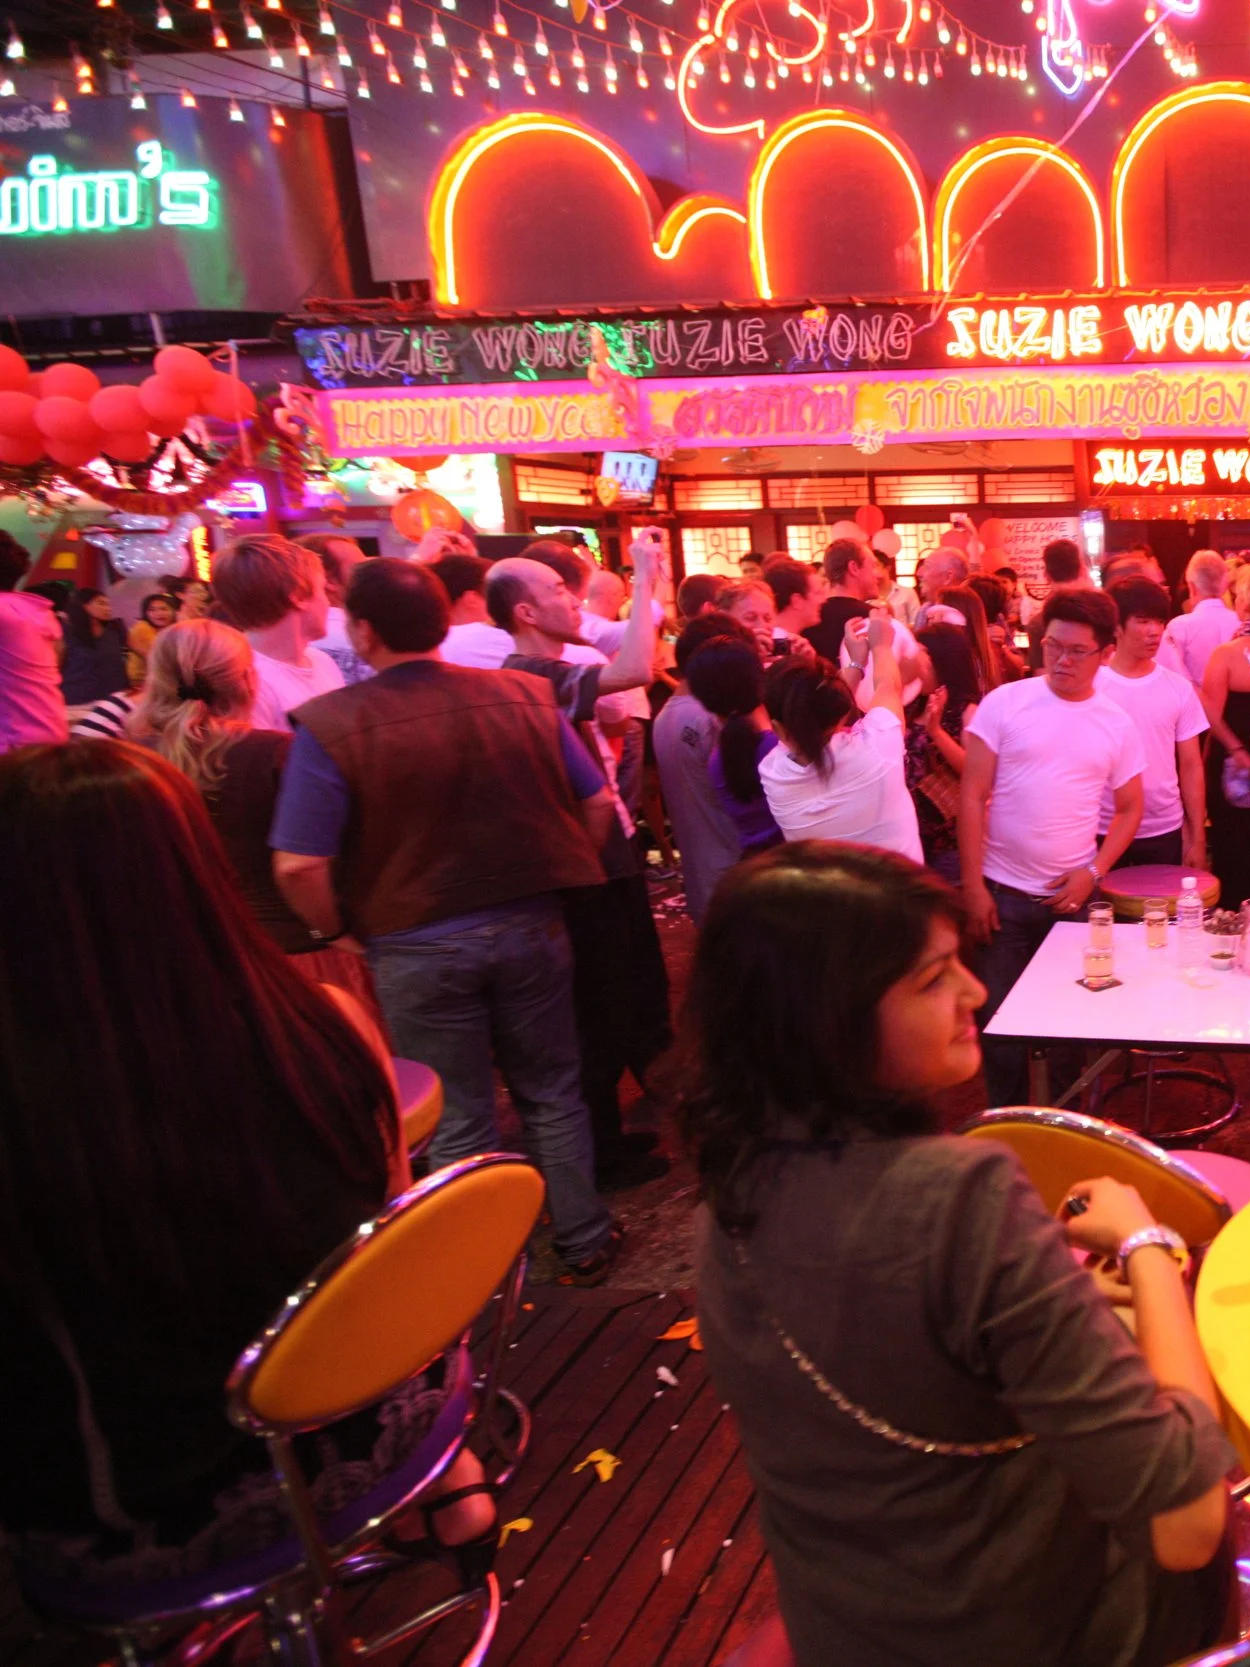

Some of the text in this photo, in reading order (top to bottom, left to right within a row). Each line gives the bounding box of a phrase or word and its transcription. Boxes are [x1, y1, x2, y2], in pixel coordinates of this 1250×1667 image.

[318, 329, 455, 378] SUZIE
[614, 313, 913, 370] SUZIE WONG
[946, 305, 1102, 360] SUZIE
[339, 398, 610, 443] Happy New Ye
[1093, 448, 1207, 487] SUZIE
